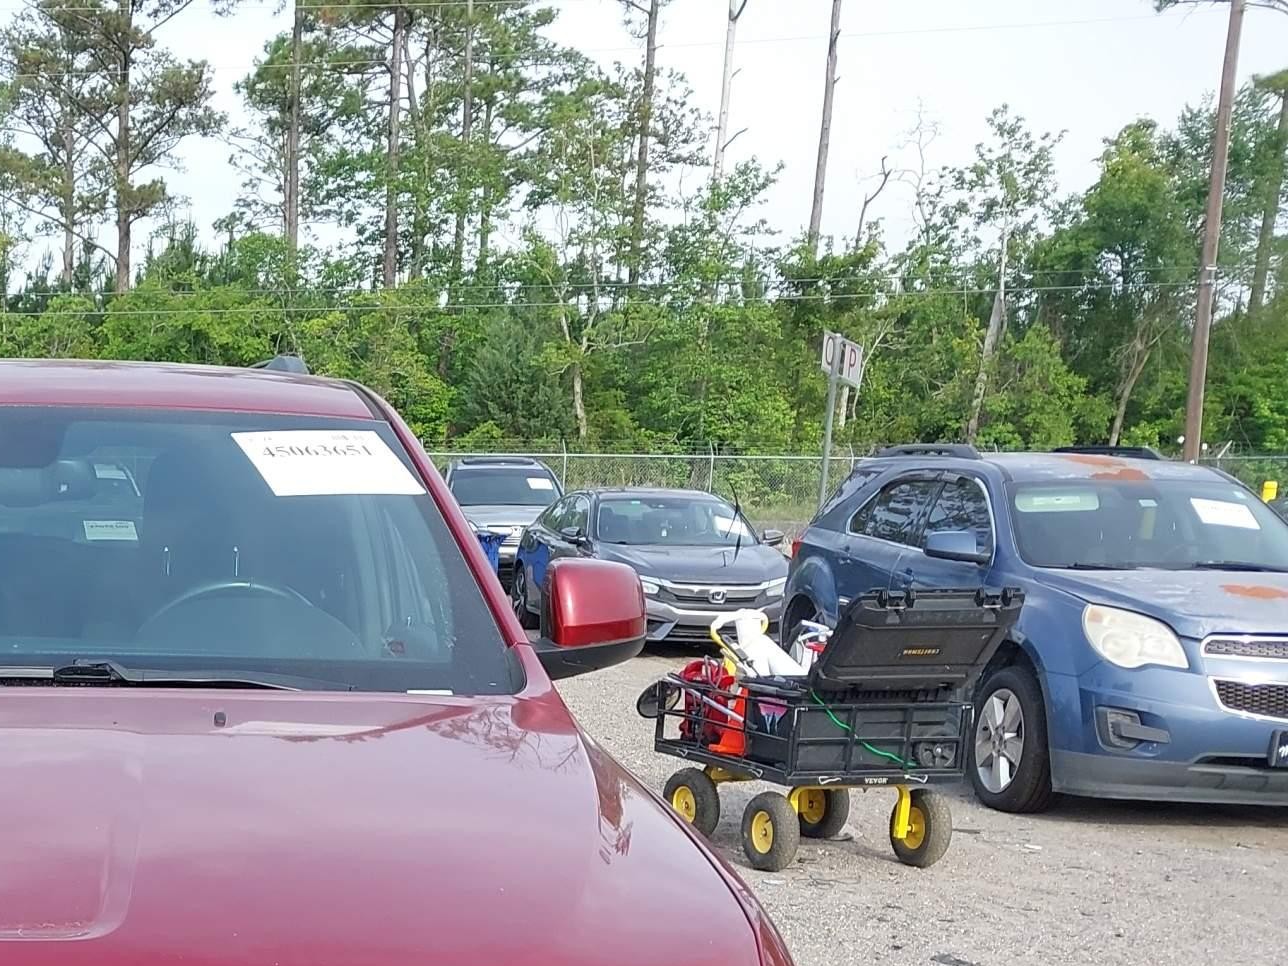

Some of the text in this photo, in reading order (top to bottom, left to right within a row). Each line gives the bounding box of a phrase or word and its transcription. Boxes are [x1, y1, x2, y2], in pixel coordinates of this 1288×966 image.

[848, 348, 857, 378] P
[264, 445, 372, 457] 45063651
[864, 776, 889, 785] VEVOR
